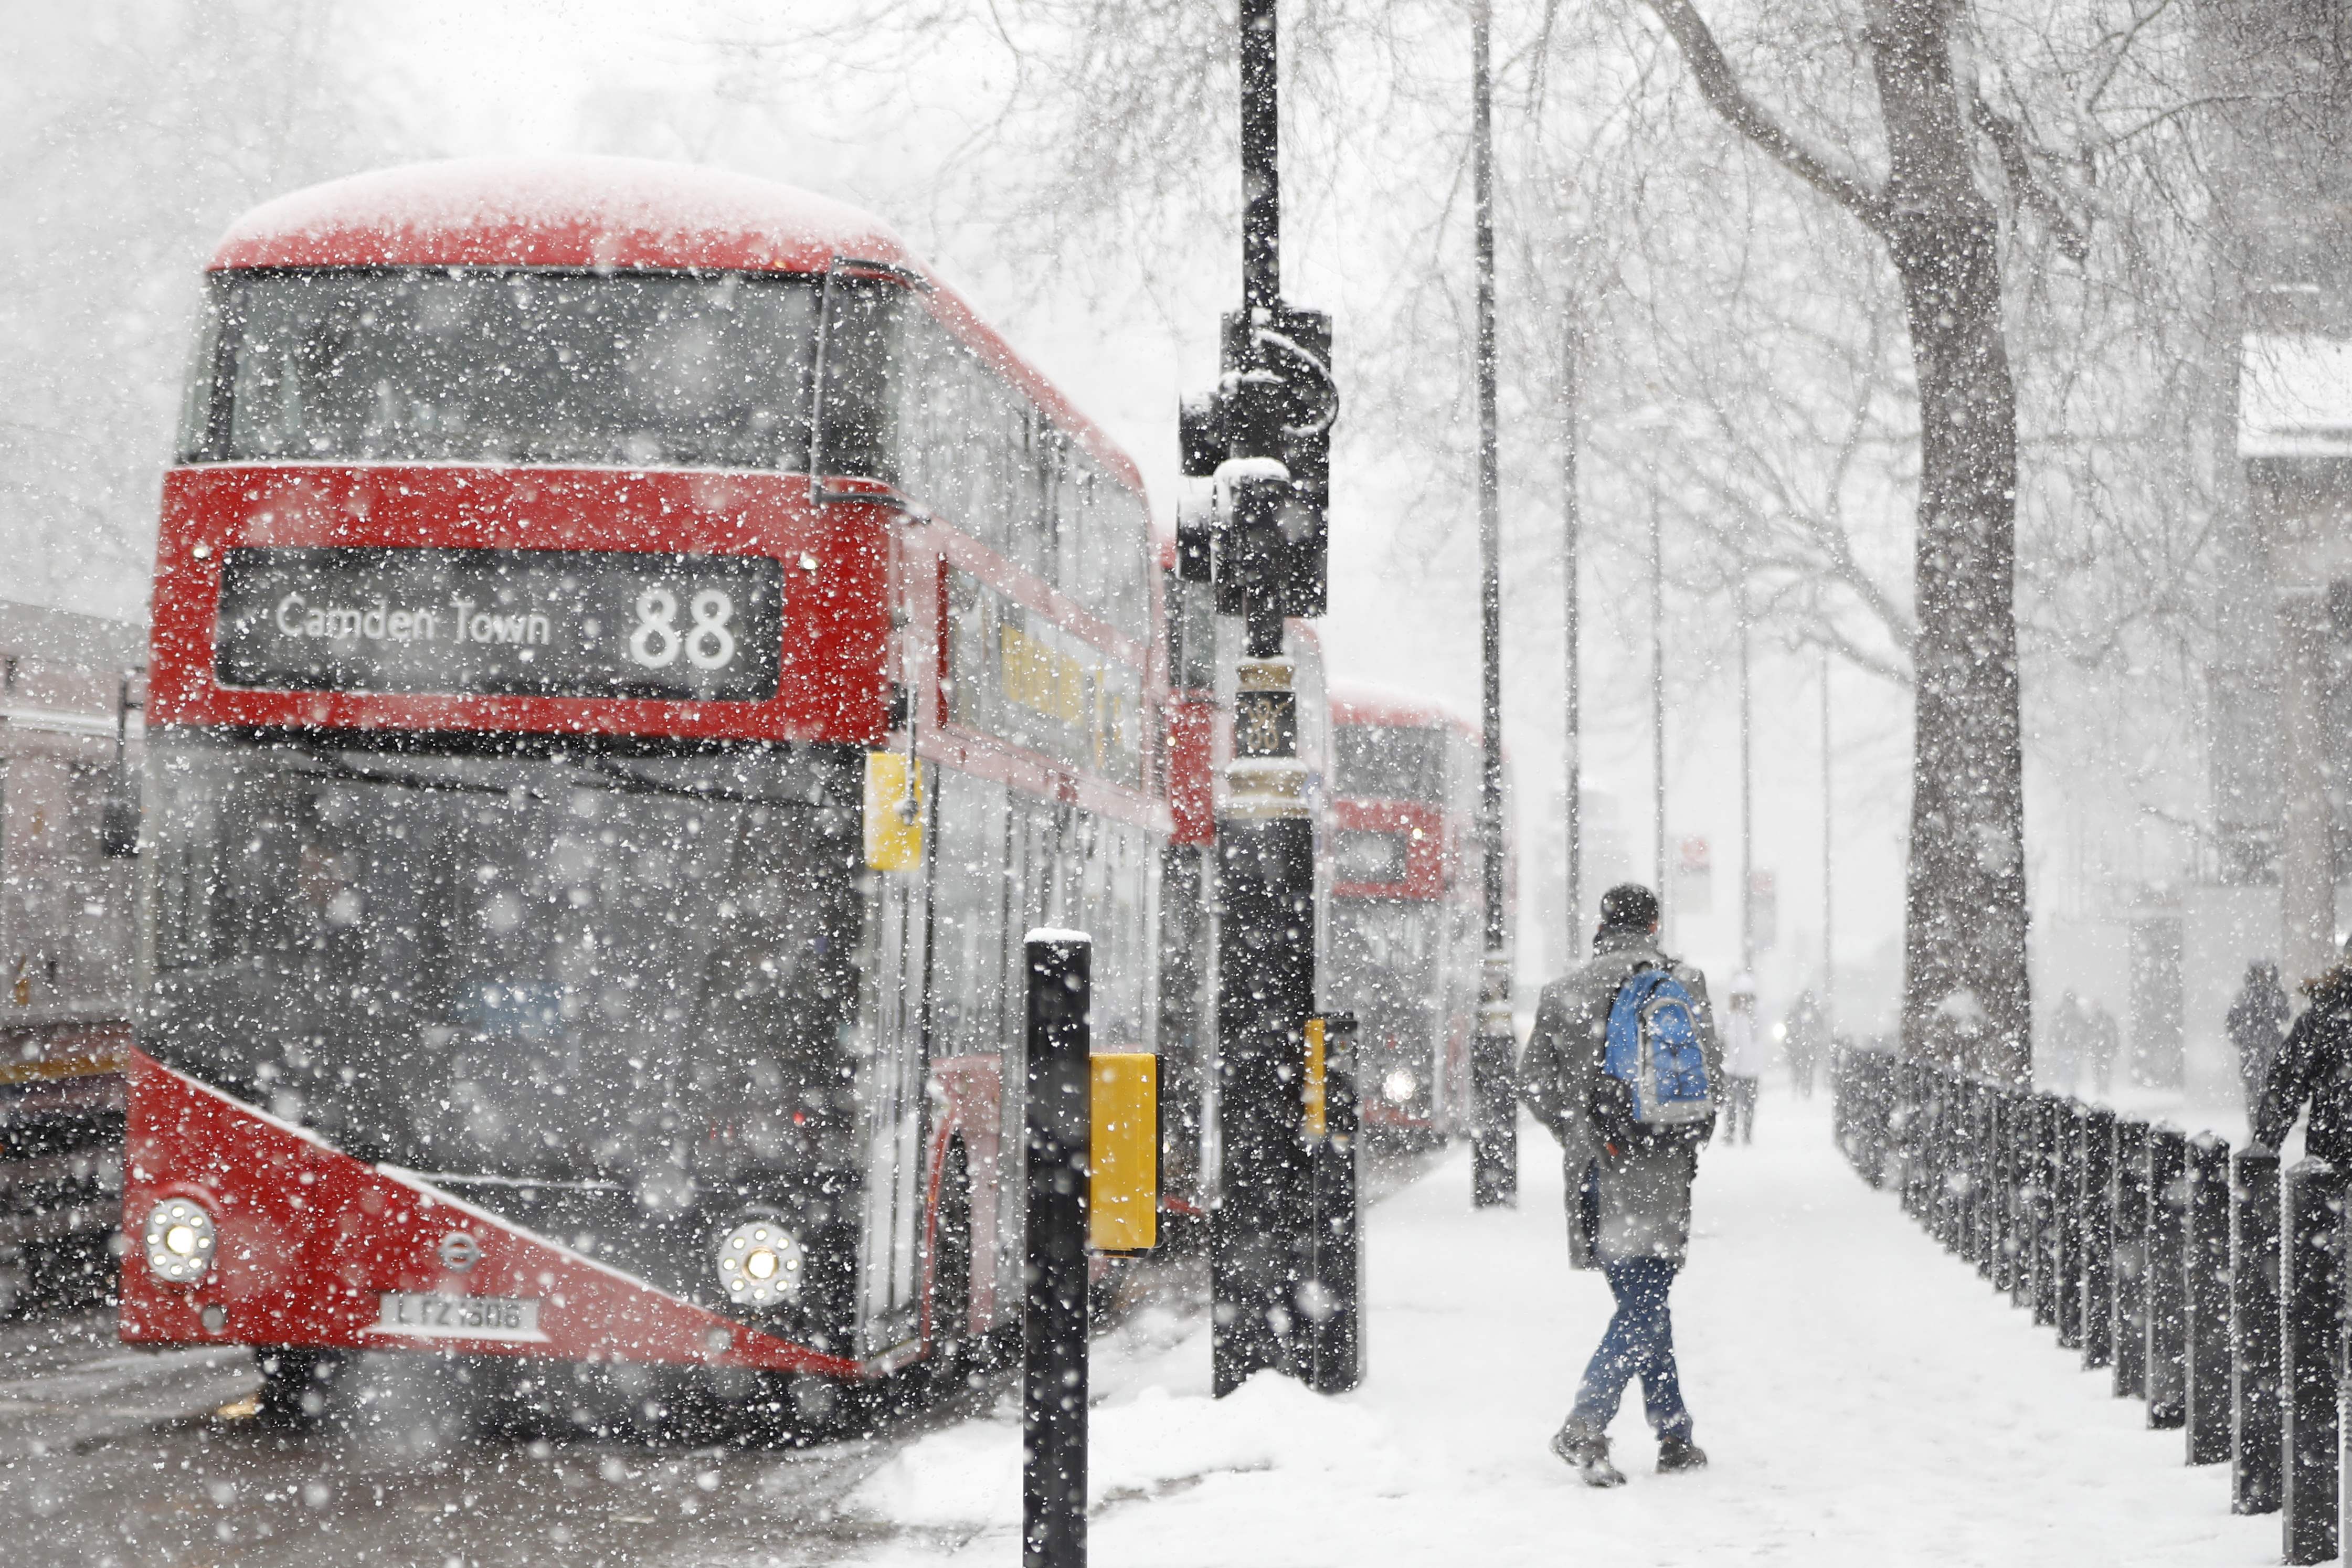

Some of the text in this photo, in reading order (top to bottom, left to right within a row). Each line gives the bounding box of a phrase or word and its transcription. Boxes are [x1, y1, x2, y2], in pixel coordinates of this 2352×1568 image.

[275, 594, 551, 645] Camden Town
[629, 588, 735, 670] 88
